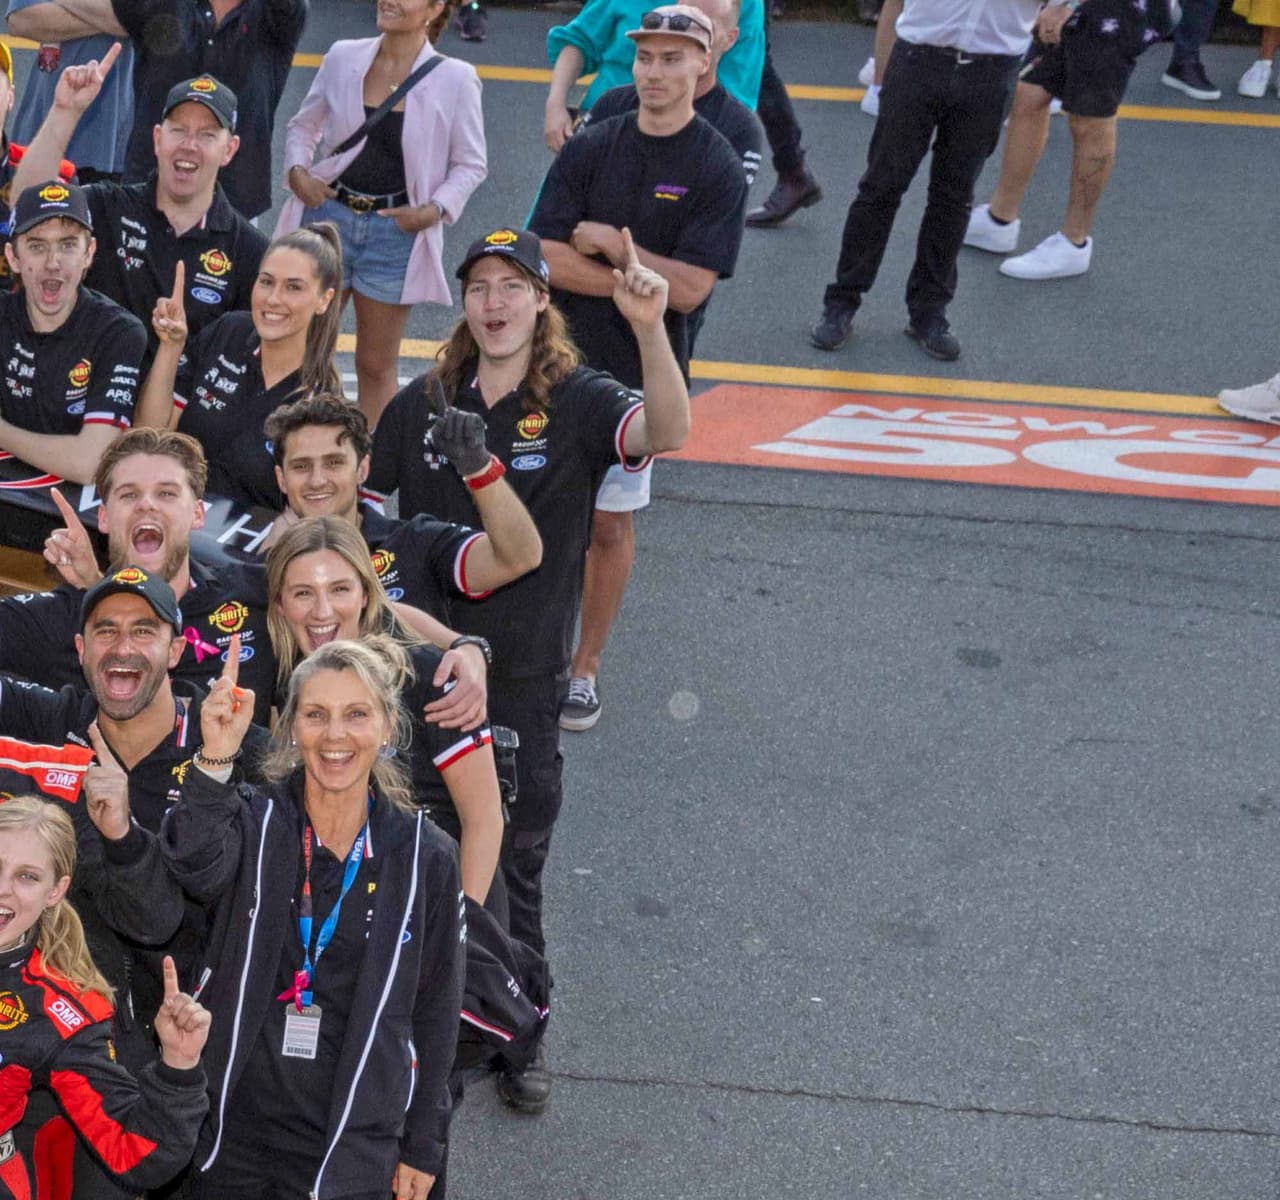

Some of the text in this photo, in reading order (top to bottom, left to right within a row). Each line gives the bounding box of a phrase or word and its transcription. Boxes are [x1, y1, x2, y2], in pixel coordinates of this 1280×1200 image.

[828, 403, 1280, 447] NOW O
[208, 605, 249, 626] PENRITE
[44, 770, 78, 788] OMP
[51, 1001, 83, 1029] OMP
